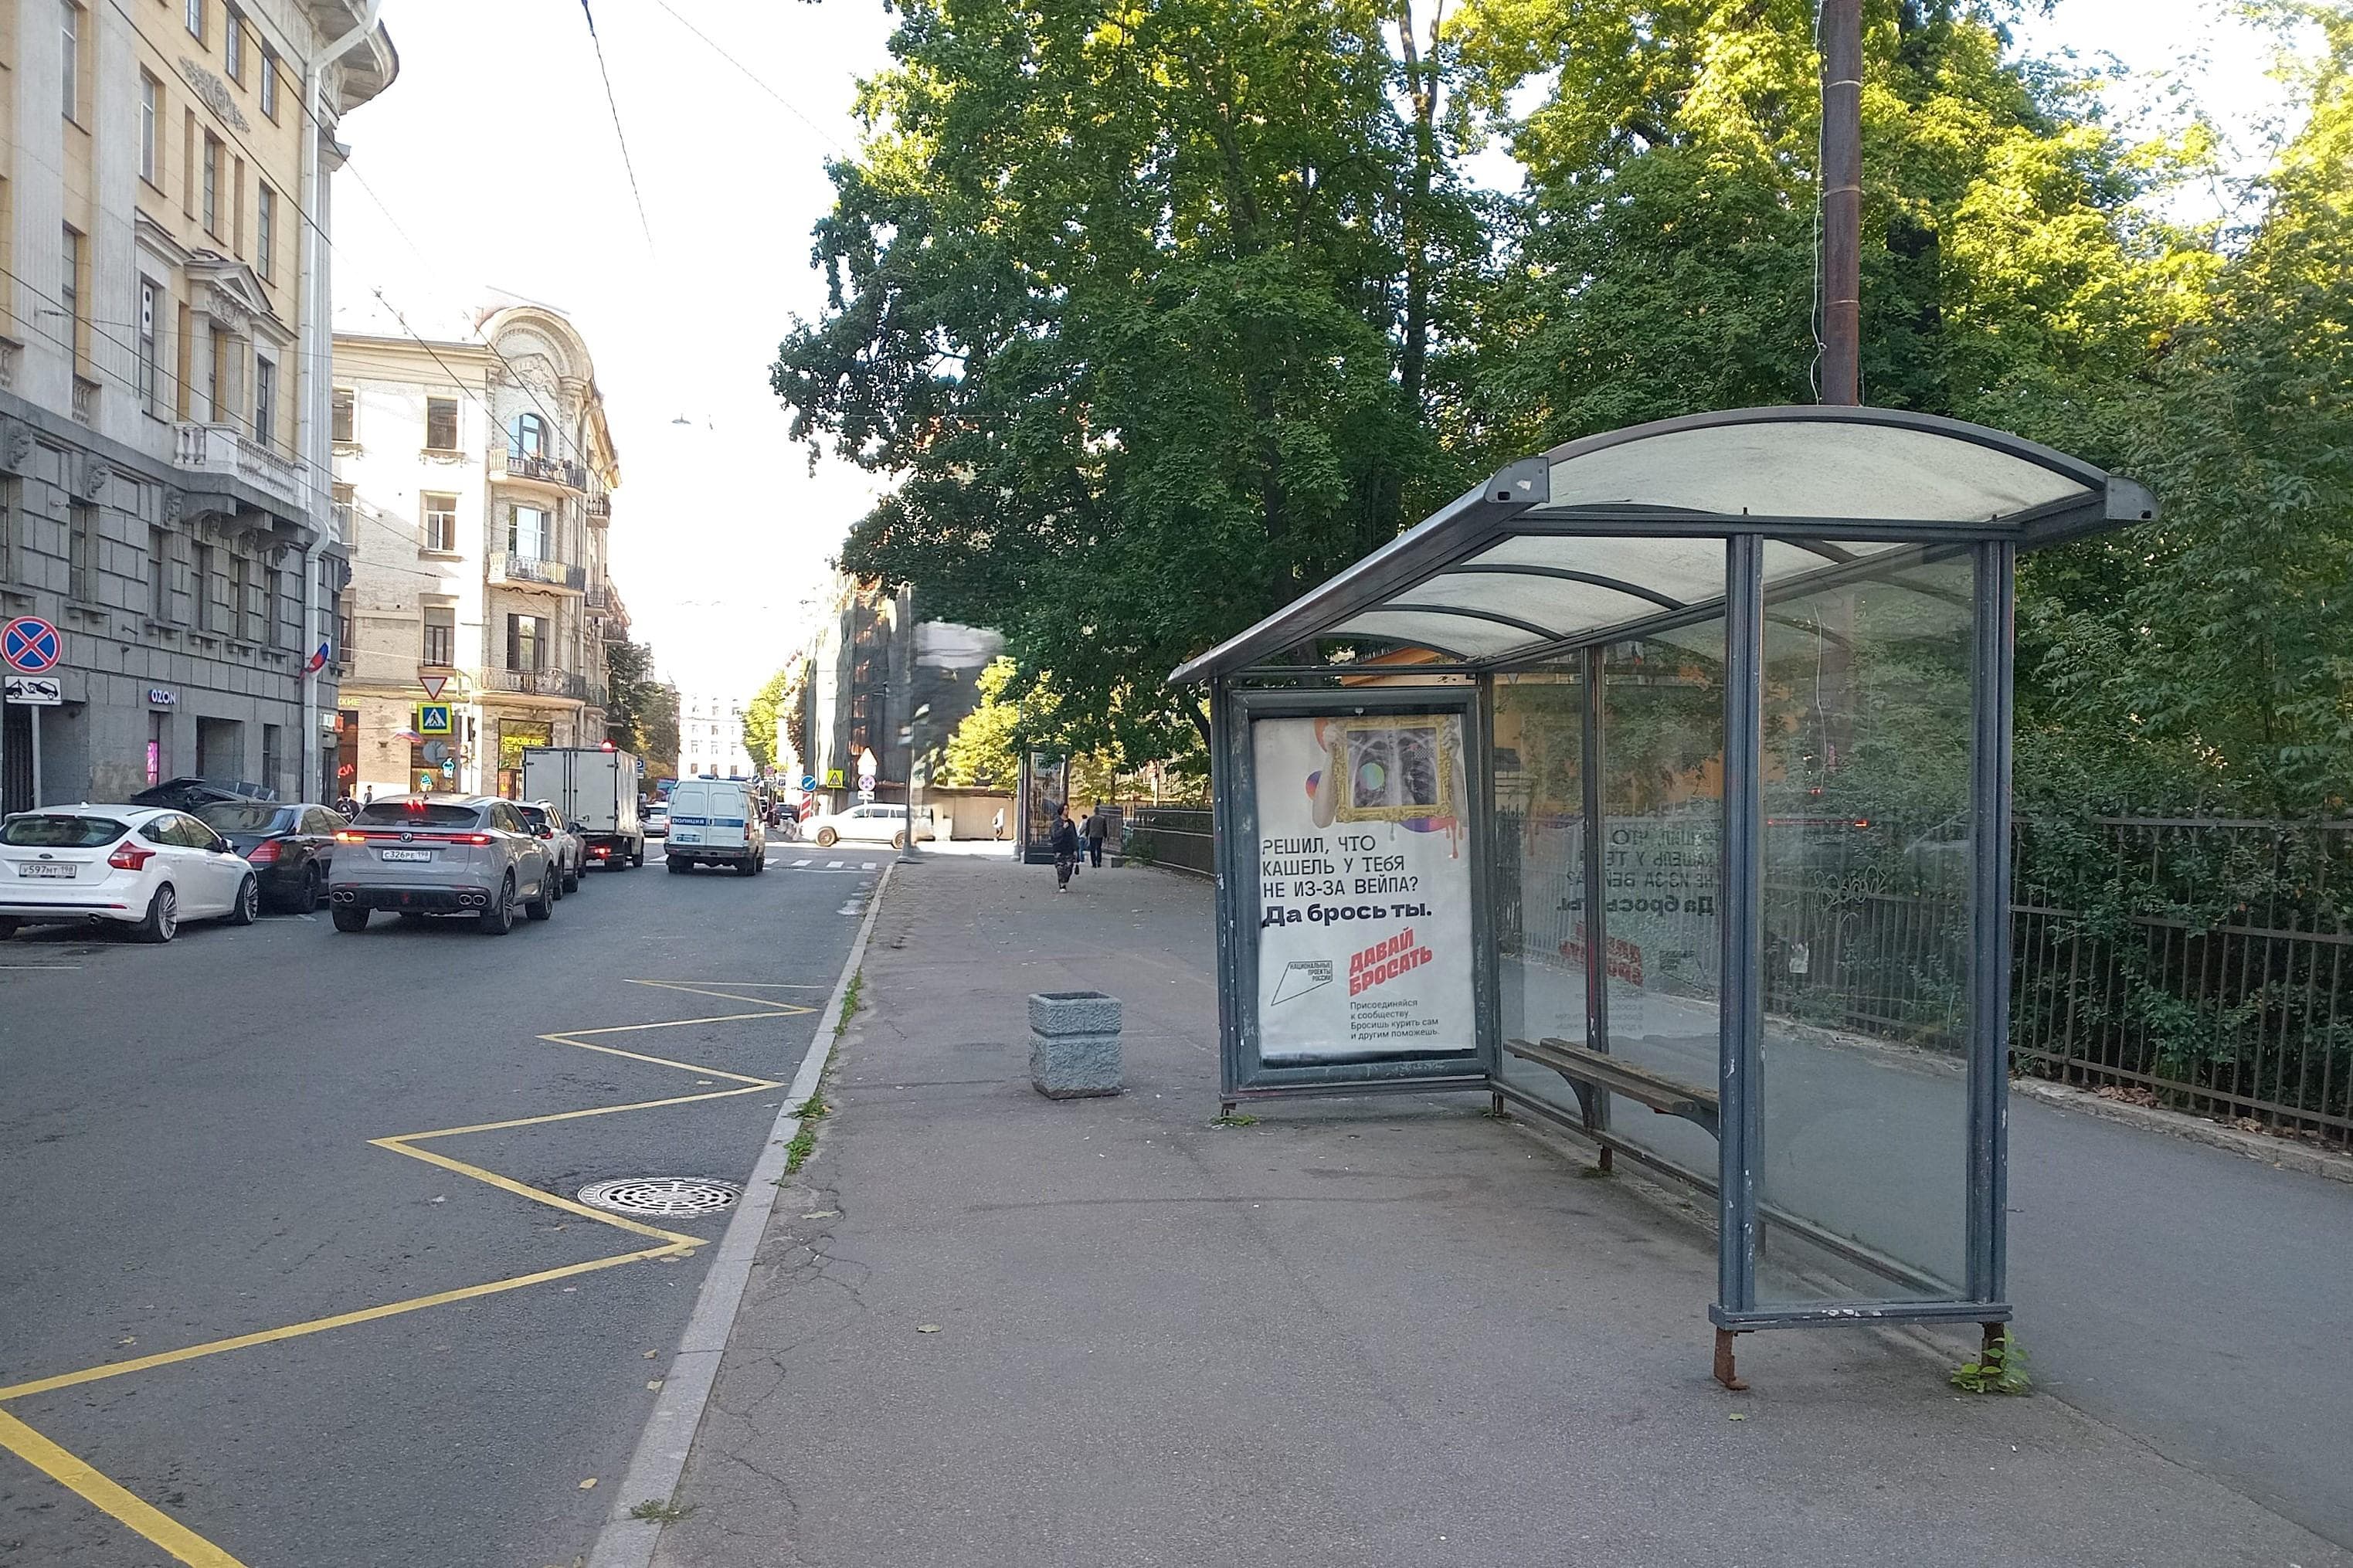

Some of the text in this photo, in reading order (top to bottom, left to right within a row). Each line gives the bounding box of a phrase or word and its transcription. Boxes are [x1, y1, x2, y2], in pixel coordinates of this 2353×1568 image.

[151, 689, 176, 704] OZON
[1261, 835, 1376, 855] РЕШИЛ, ЧТО
[1262, 859, 1335, 877] КАШЕЛЬ
[1343, 857, 1353, 874] У
[1263, 874, 1418, 898] НЕ ИЗ-ЗА ВЕЙПА?
[1261, 903, 1432, 929] Да брось ты.
[1350, 927, 1414, 977] ДАВАЙ
[1350, 946, 1434, 997] БРОСАТЬ
[1350, 999, 1418, 1011] Присоединяйся
[1350, 1021, 1390, 1031] Бросишь
[1391, 1020, 1421, 1029] курить
[1358, 1031, 1389, 1040] другим
[1391, 1029, 1441, 1038] поможешь.
